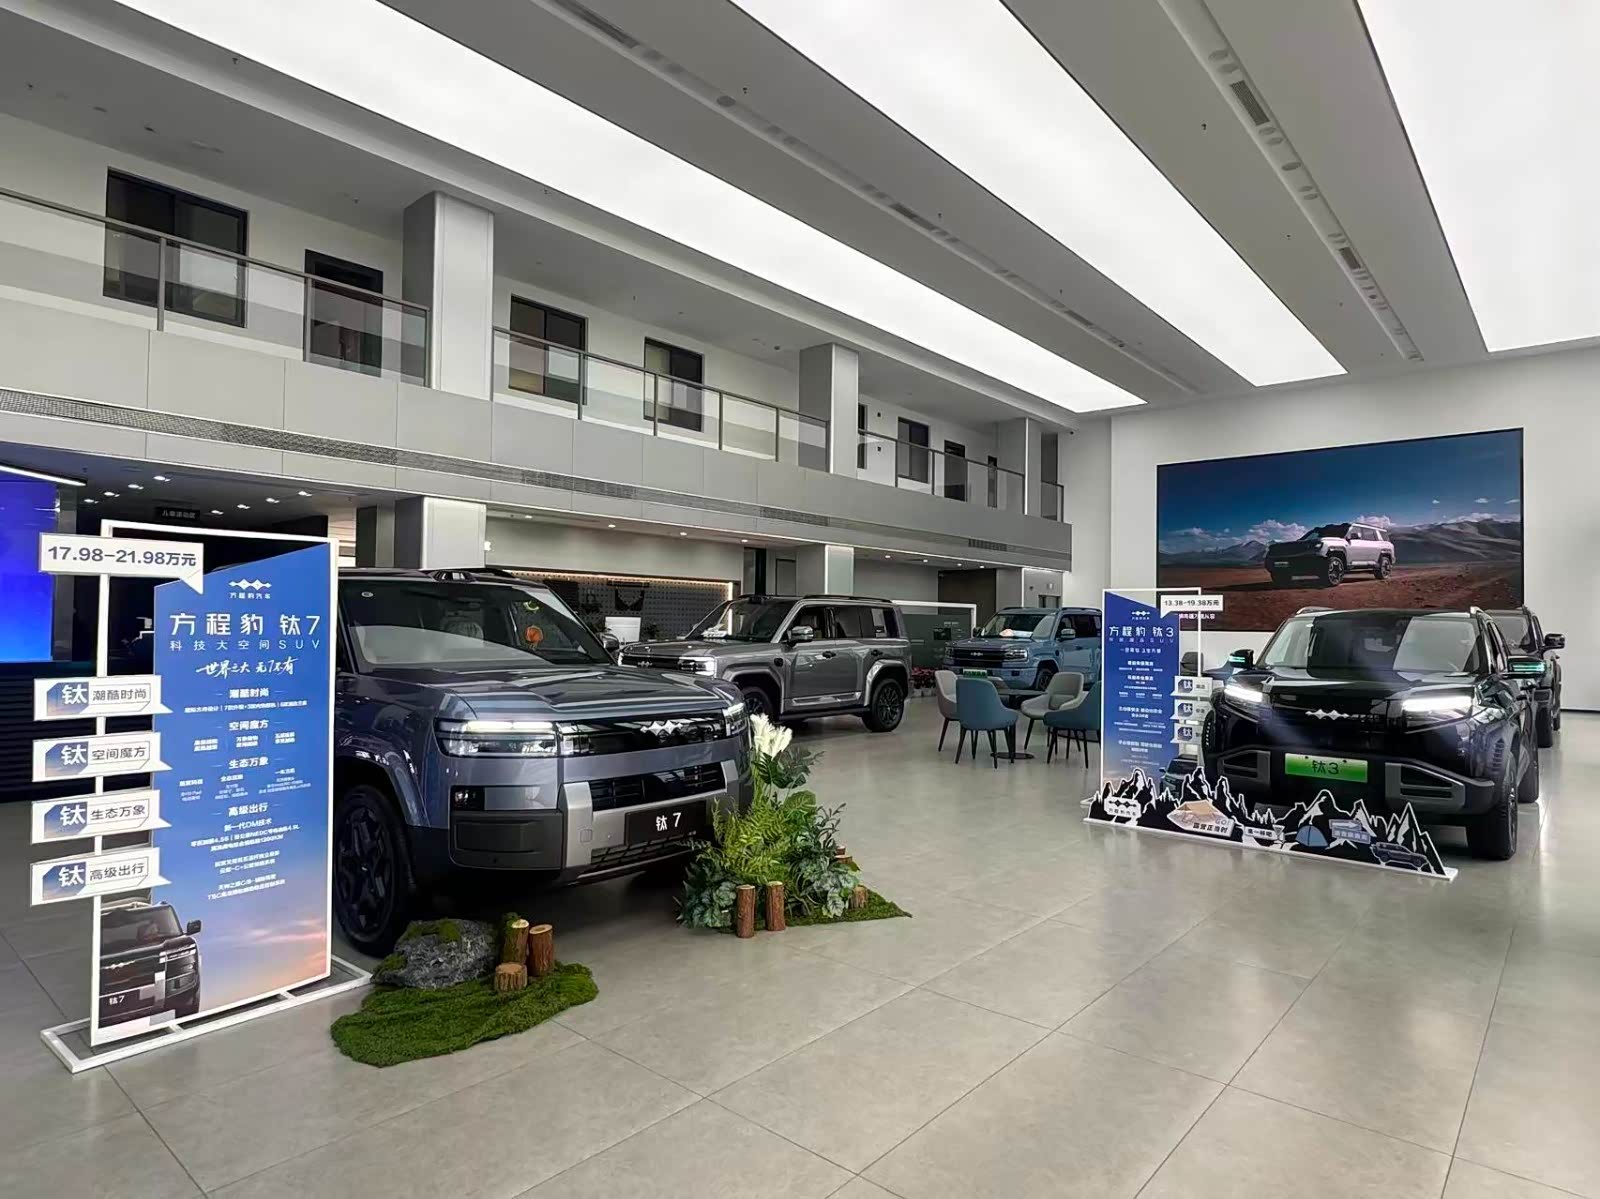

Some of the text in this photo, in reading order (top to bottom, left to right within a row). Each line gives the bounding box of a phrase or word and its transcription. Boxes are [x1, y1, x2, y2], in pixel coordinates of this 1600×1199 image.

[48, 546, 197, 567] 17.98-21.98万元
[170, 613, 321, 636] 方程豹 钛7
[1109, 626, 1174, 637] 方程豹 钛3
[169, 639, 321, 652] 科技大空间SUV
[62, 684, 147, 705] 钛 潮酷时尚
[229, 688, 270, 699] 潮酷时尚
[229, 719, 269, 731] 空间魔方
[61, 744, 146, 765] 钛 空间魔方
[228, 756, 269, 769] 生态万象
[1312, 760, 1339, 775] 钛3
[60, 804, 146, 826] 钛 生态万象
[228, 802, 268, 817] 高级出行
[656, 812, 682, 831] 钛7
[1192, 823, 1229, 833] 露营正当时
[59, 862, 145, 887] 钛 高级出行
